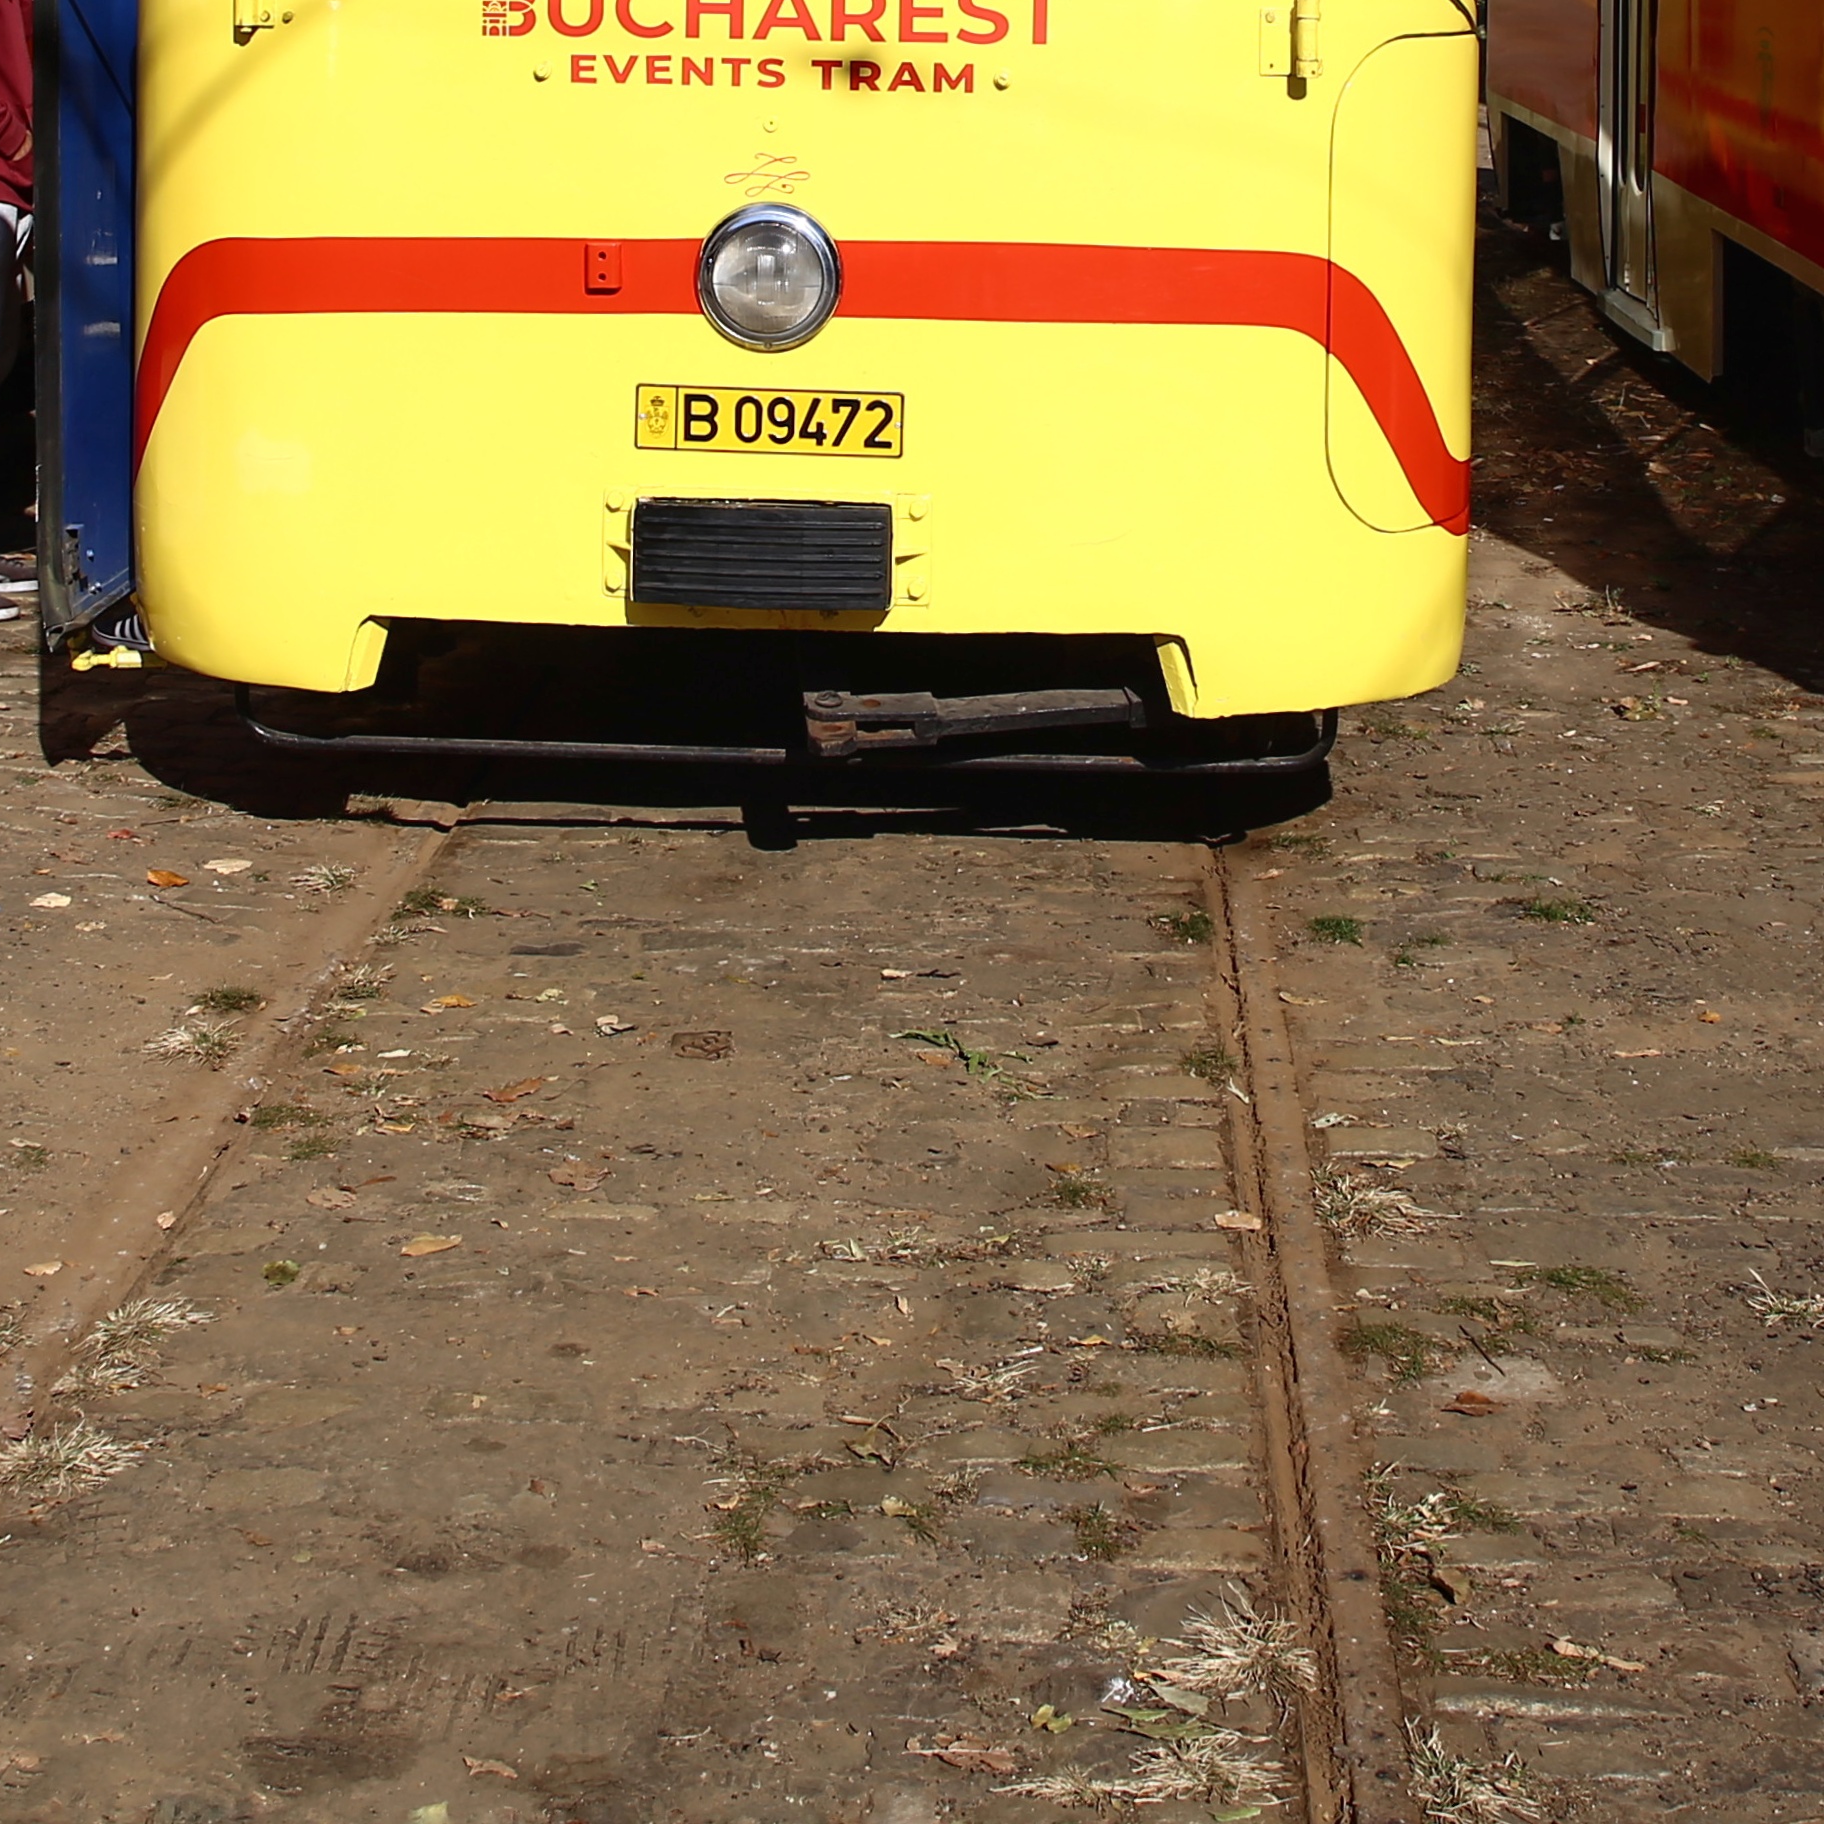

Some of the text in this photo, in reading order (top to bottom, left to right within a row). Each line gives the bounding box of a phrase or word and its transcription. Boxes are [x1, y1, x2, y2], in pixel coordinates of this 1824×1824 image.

[570, 54, 976, 94] EVENTS TRAM
[682, 393, 895, 450] B 09472
